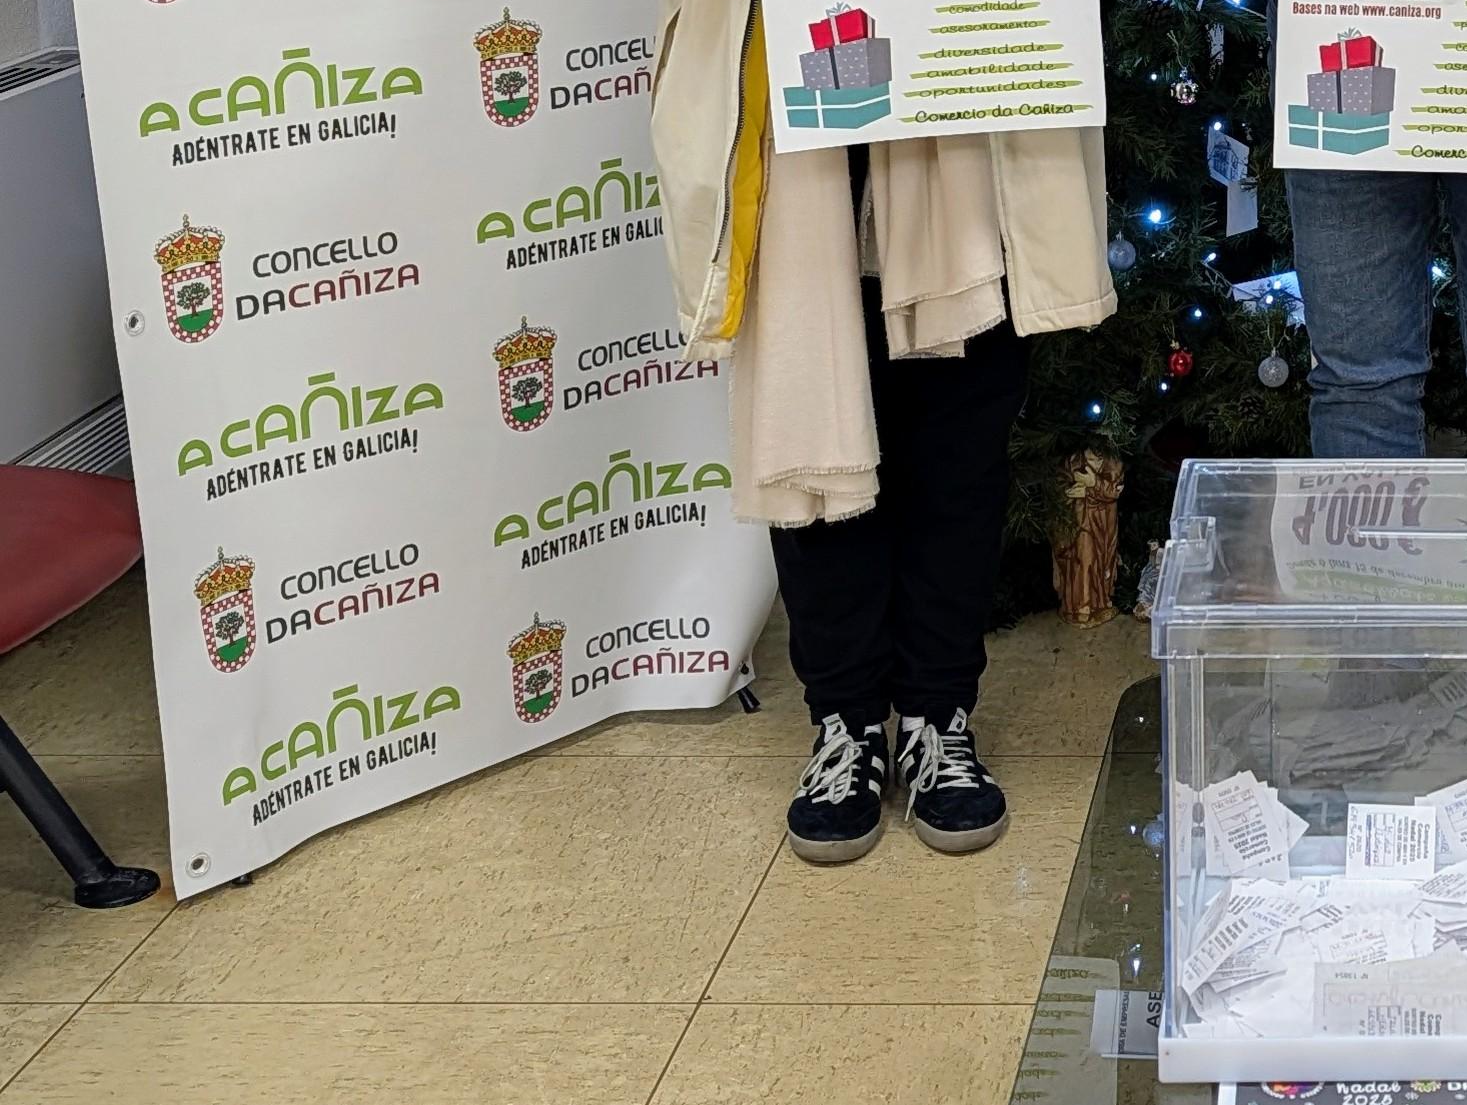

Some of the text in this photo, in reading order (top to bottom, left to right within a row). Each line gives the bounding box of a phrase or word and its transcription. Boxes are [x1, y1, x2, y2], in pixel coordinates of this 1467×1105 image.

[1292, 2, 1441, 20] Bases na web www.caniza.org
[915, 103, 1074, 123] Comercio da Cañiza
[173, 112, 396, 167] ADÉNTRATE EN GALICIA!
[253, 232, 398, 278] CONCELLO
[578, 329, 688, 372] CONCELL
[207, 428, 418, 501] ADÉNTRATE EN GALICIA!
[522, 503, 706, 569] ADÉNTRATE EN GALICIA!
[281, 544, 419, 601] CONCELLO
[586, 617, 710, 659] CONCELLO
[253, 732, 436, 826] ADÉNTRATE EN GALICIA!
